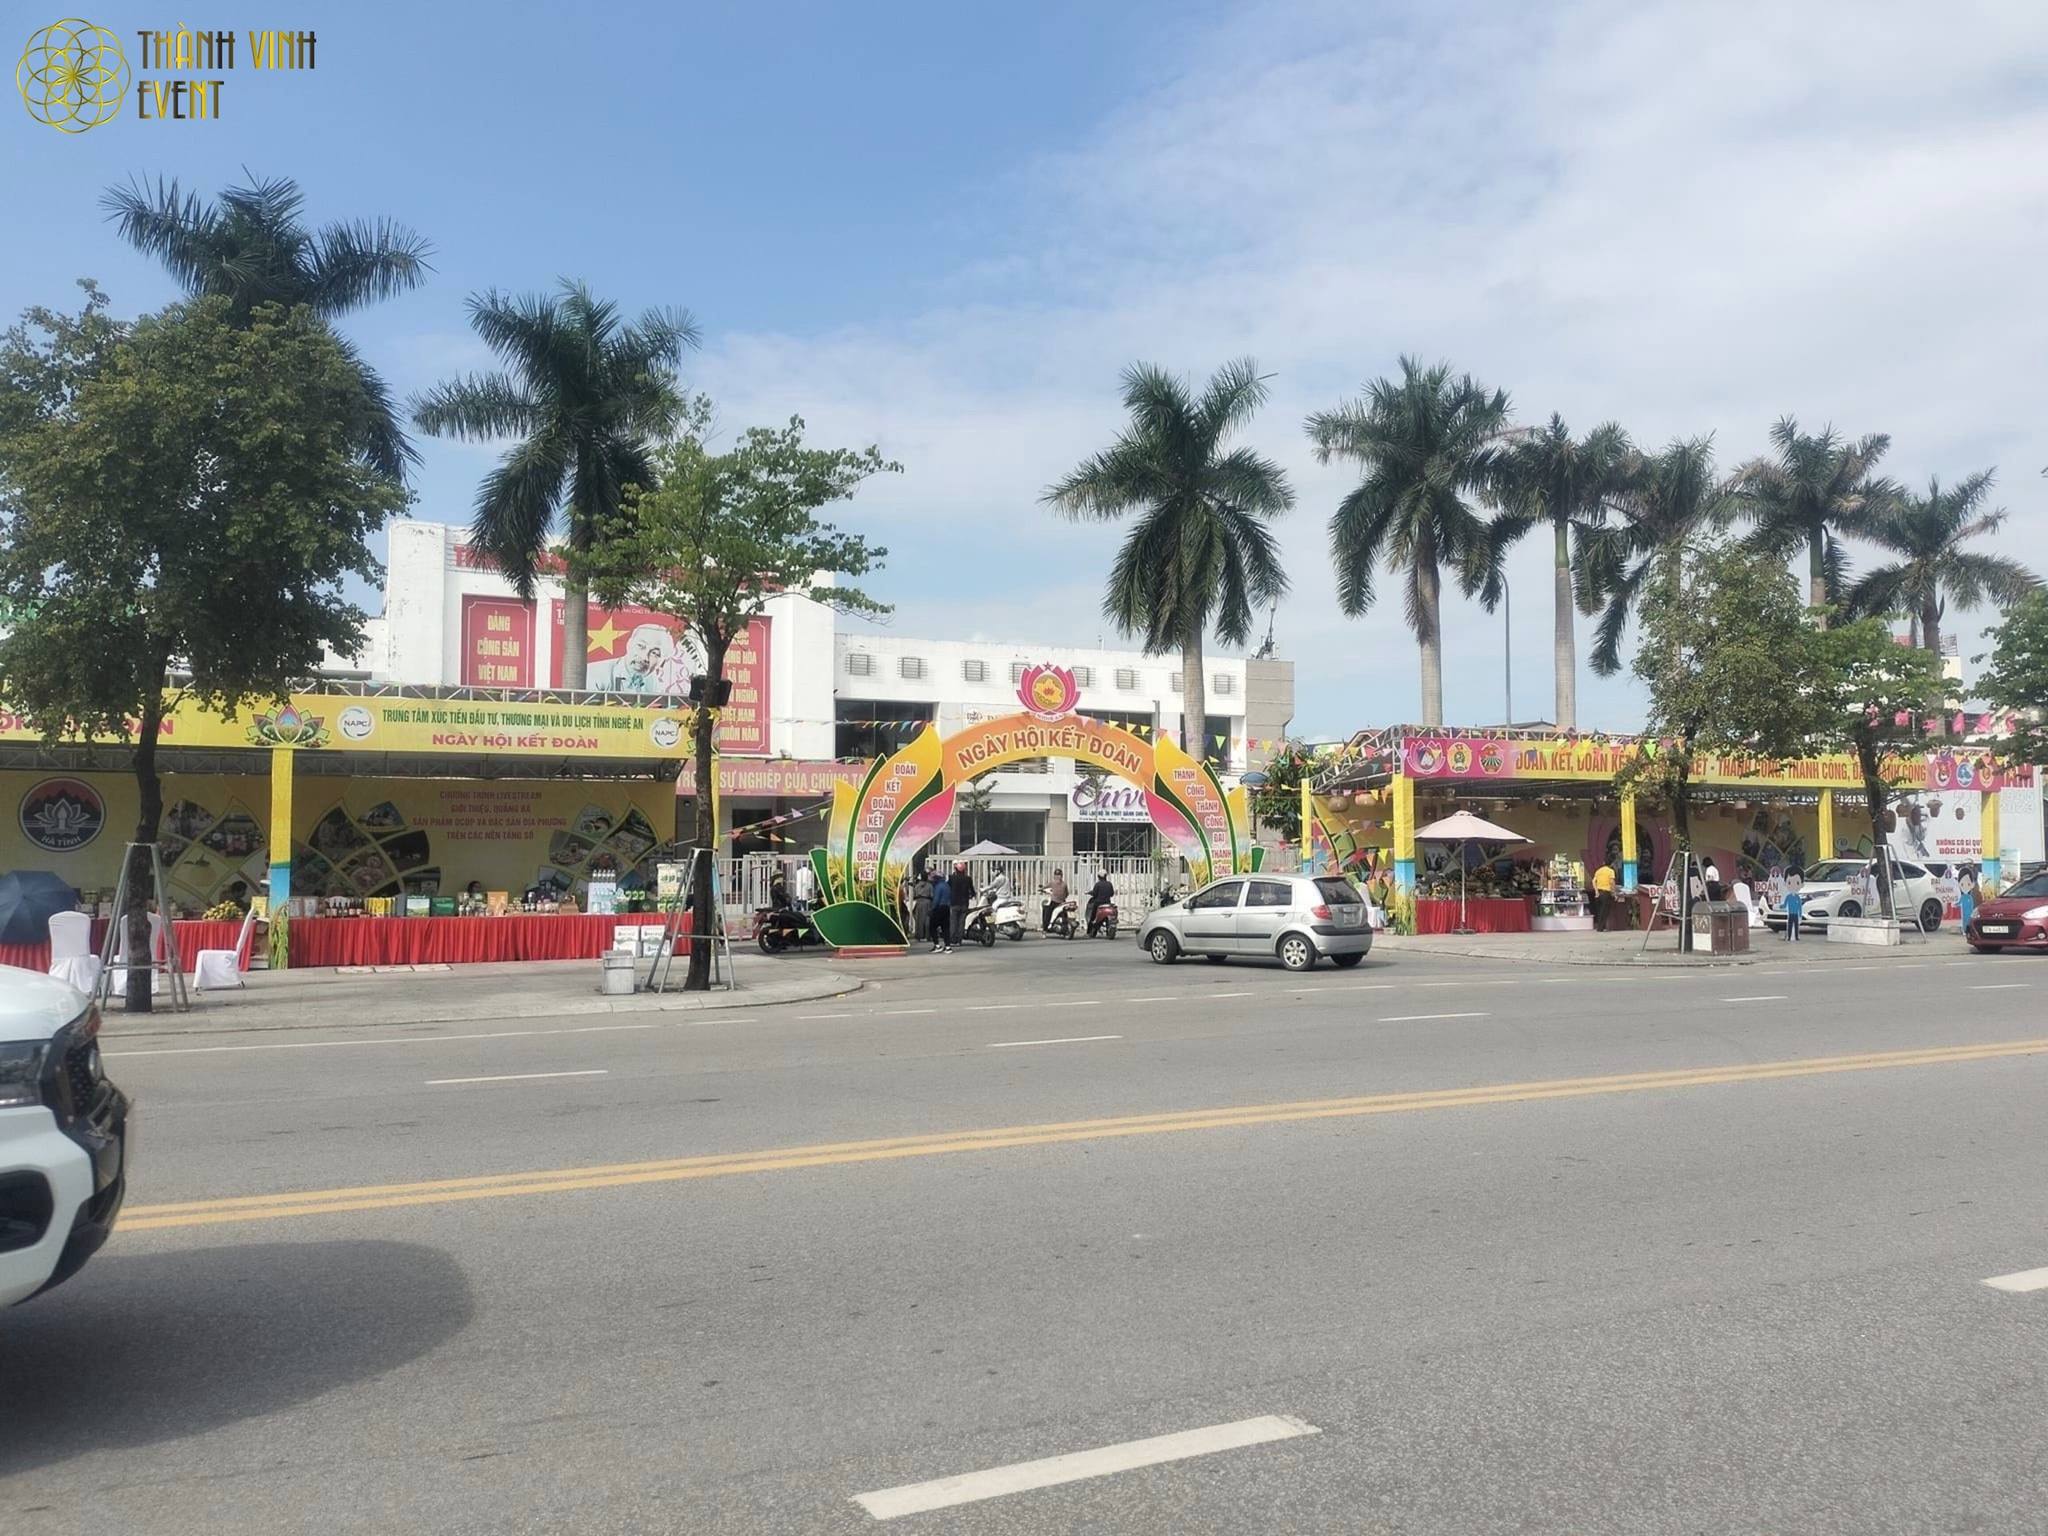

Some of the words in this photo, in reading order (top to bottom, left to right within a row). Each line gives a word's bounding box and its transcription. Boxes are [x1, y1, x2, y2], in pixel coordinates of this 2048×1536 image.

[487, 610, 511, 632] ĐẢNG
[477, 637, 501, 660] CỘNG
[502, 636, 520, 657] SẢN
[478, 662, 496, 684] VIỆT
[497, 665, 518, 682] NAM
[344, 719, 369, 727] NAPC
[382, 709, 409, 723] TRUNG
[411, 708, 430, 723] TÂM
[431, 708, 447, 724] XÚC
[450, 708, 468, 725] TIẾN
[469, 709, 485, 726] ĐẦU
[487, 712, 500, 727] TƯ,
[501, 713, 532, 727] THƯƠNG
[533, 714, 549, 730] MẠI
[550, 712, 561, 728] VÀ
[562, 715, 573, 728] DU
[574, 716, 591, 731] LỊCH
[593, 712, 610, 729] TỈNH
[611, 715, 632, 733] NGHỆ
[632, 718, 644, 730] AN
[655, 729, 675, 737] NAPC
[432, 731, 479, 746] NGÀY
[482, 732, 512, 750] HỘI
[517, 732, 548, 748] KẾT
[551, 734, 599, 749] ĐOÀN
[957, 734, 1009, 769] NGÀY
[1014, 726, 1045, 753] HỘI
[1049, 726, 1086, 750] KẾT
[1088, 736, 1142, 775] ĐOÀN
[895, 761, 917, 775] ĐOÀN
[1174, 767, 1195, 780] THÀNH
[719, 769, 736, 792] SỰ
[738, 768, 781, 791] NGHIỆP
[784, 766, 809, 790] CỦA
[886, 777, 900, 792] KẾT
[1186, 783, 1205, 796] CÔNG
[872, 796, 895, 809] ĐOÀN
[1196, 799, 1218, 812] THÀNH
[868, 811, 882, 826] KẾT
[1205, 815, 1224, 828] CÔNG
[864, 833, 878, 847] ĐẠI
[857, 849, 879, 862] ĐOÀN
[1211, 847, 1232, 859] THÀNH
[860, 864, 875, 879] KẾT
